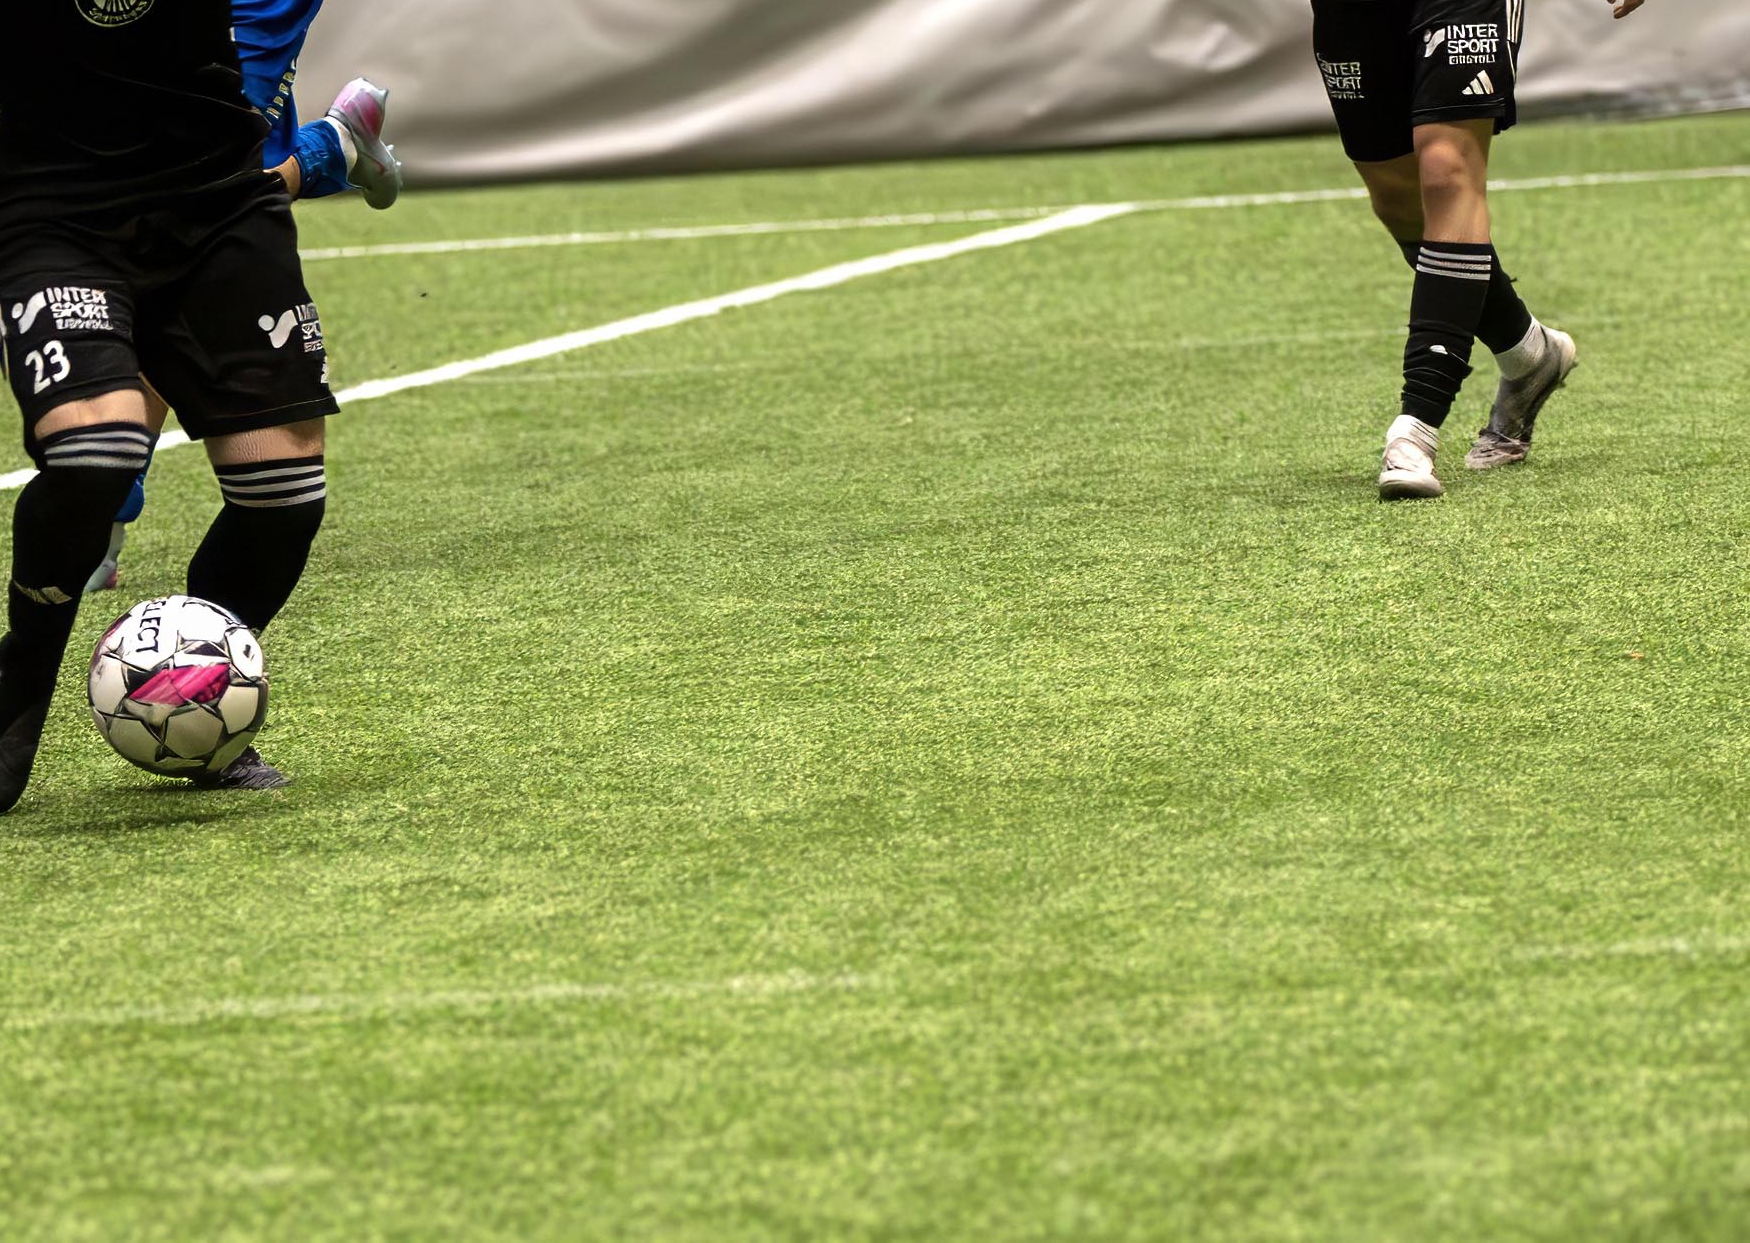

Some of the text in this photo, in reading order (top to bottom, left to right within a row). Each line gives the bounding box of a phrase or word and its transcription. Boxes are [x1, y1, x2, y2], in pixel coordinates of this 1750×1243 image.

[1447, 23, 1498, 39] INTER
[1447, 38, 1500, 54] SPORT
[45, 286, 107, 305] INTER
[50, 301, 110, 319] SPORT
[25, 339, 71, 395] 23
